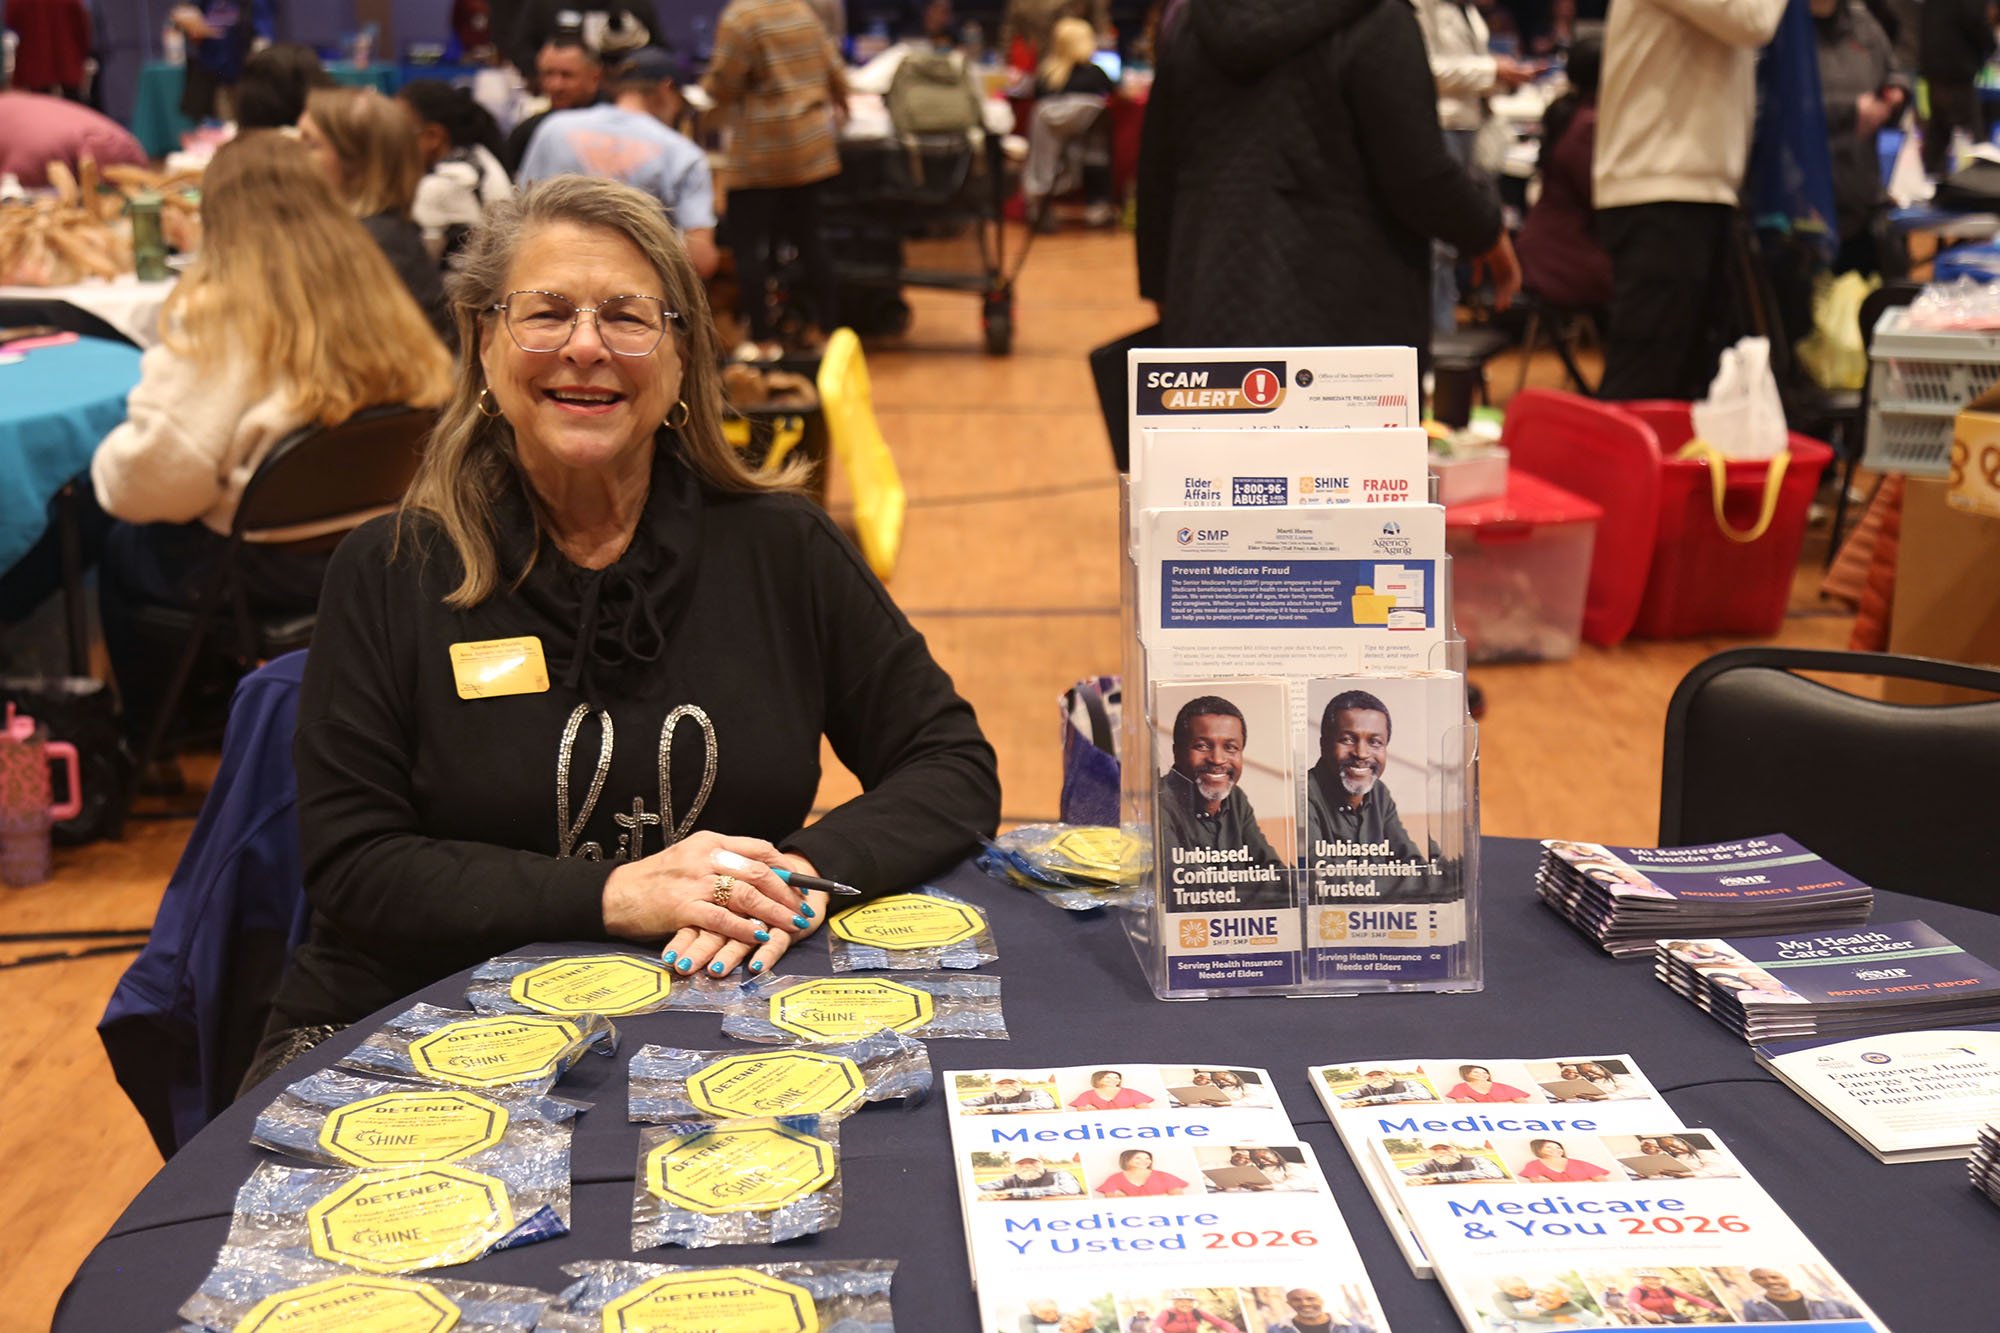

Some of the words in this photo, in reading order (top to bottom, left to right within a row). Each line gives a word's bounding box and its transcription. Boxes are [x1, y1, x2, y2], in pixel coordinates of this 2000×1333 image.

[1147, 371, 1209, 388] SCAM
[1170, 390, 1240, 407] ALERT
[1185, 478, 1212, 488] Elder
[1234, 484, 1286, 494] 1-800-96-
[1315, 478, 1349, 488] SHINE
[1363, 480, 1408, 490] FRAUD
[1184, 489, 1221, 500] Affairs
[1234, 495, 1268, 504] ABUSE
[1198, 530, 1229, 540] SMP
[1372, 540, 1408, 548] Agency
[1172, 566, 1210, 575] Prevent
[1213, 566, 1259, 575] Medicare
[1262, 566, 1290, 575] Fraud
[1172, 845, 1253, 864] Unbiased.
[1315, 840, 1394, 856] Unbiased.
[1638, 854, 1709, 864] Atención
[1713, 852, 1733, 861] de
[1737, 846, 1783, 858] Salud
[1656, 844, 1742, 857] Rastreador
[1749, 840, 1768, 848] de
[1173, 864, 1281, 884] Confidential.
[1315, 860, 1421, 876] Confidential.
[1316, 880, 1380, 896] Trusted.
[1727, 874, 1768, 885] SMP
[1173, 886, 1241, 905] Trusted.
[862, 904, 933, 914] DETENER
[1210, 917, 1278, 937] SHINE
[1349, 912, 1417, 930] SHINE
[877, 926, 918, 936] SHINE
[1776, 941, 1813, 953] My
[1814, 932, 1891, 947] Health
[1778, 949, 1831, 960] Care
[1834, 940, 1915, 955] Tracker
[1178, 962, 1210, 970] Serving
[1212, 960, 1240, 968] Health
[1242, 959, 1283, 967] Insurance
[1318, 953, 1347, 962] Serving
[1350, 953, 1378, 961] Health
[534, 964, 594, 988] DETENER
[1238, 970, 1263, 978] Elders
[1864, 968, 1907, 979] SMP
[579, 987, 618, 1004] SHINE
[1827, 988, 1882, 997] PROTECT
[1886, 983, 1930, 993] DETECT
[1934, 979, 1980, 989] REPORT
[812, 1013, 857, 1022] SHINE
[448, 1027, 530, 1043] DETENER
[462, 1054, 512, 1068] SHINE
[712, 1062, 768, 1094] DETENER
[1827, 1065, 1930, 1081] Emergency
[1933, 1061, 1988, 1071] Home
[1838, 1078, 1902, 1089] Energy
[1848, 1089, 1877, 1098] for
[1881, 1086, 1910, 1094] the
[1914, 1079, 1982, 1092] Elderly
[767, 1088, 808, 1108] SHINE
[1858, 1094, 1942, 1106] Program
[992, 1121, 1210, 1143] Medicare
[1378, 1116, 1597, 1134] Medicare
[367, 1134, 419, 1146] SHINE
[672, 1135, 739, 1172] DETENER
[356, 1181, 452, 1206] DETENER
[1448, 1196, 1685, 1218] Medicare
[1004, 1212, 1219, 1233] Medicare
[1464, 1223, 1498, 1240] &
[1507, 1218, 1607, 1237] You
[1620, 1216, 1751, 1235] 2026
[369, 1228, 422, 1246] SHINE
[1006, 1239, 1037, 1256] Y
[1050, 1234, 1186, 1254] Usted
[1202, 1230, 1318, 1250] 2026
[654, 1289, 756, 1303] DETENER
